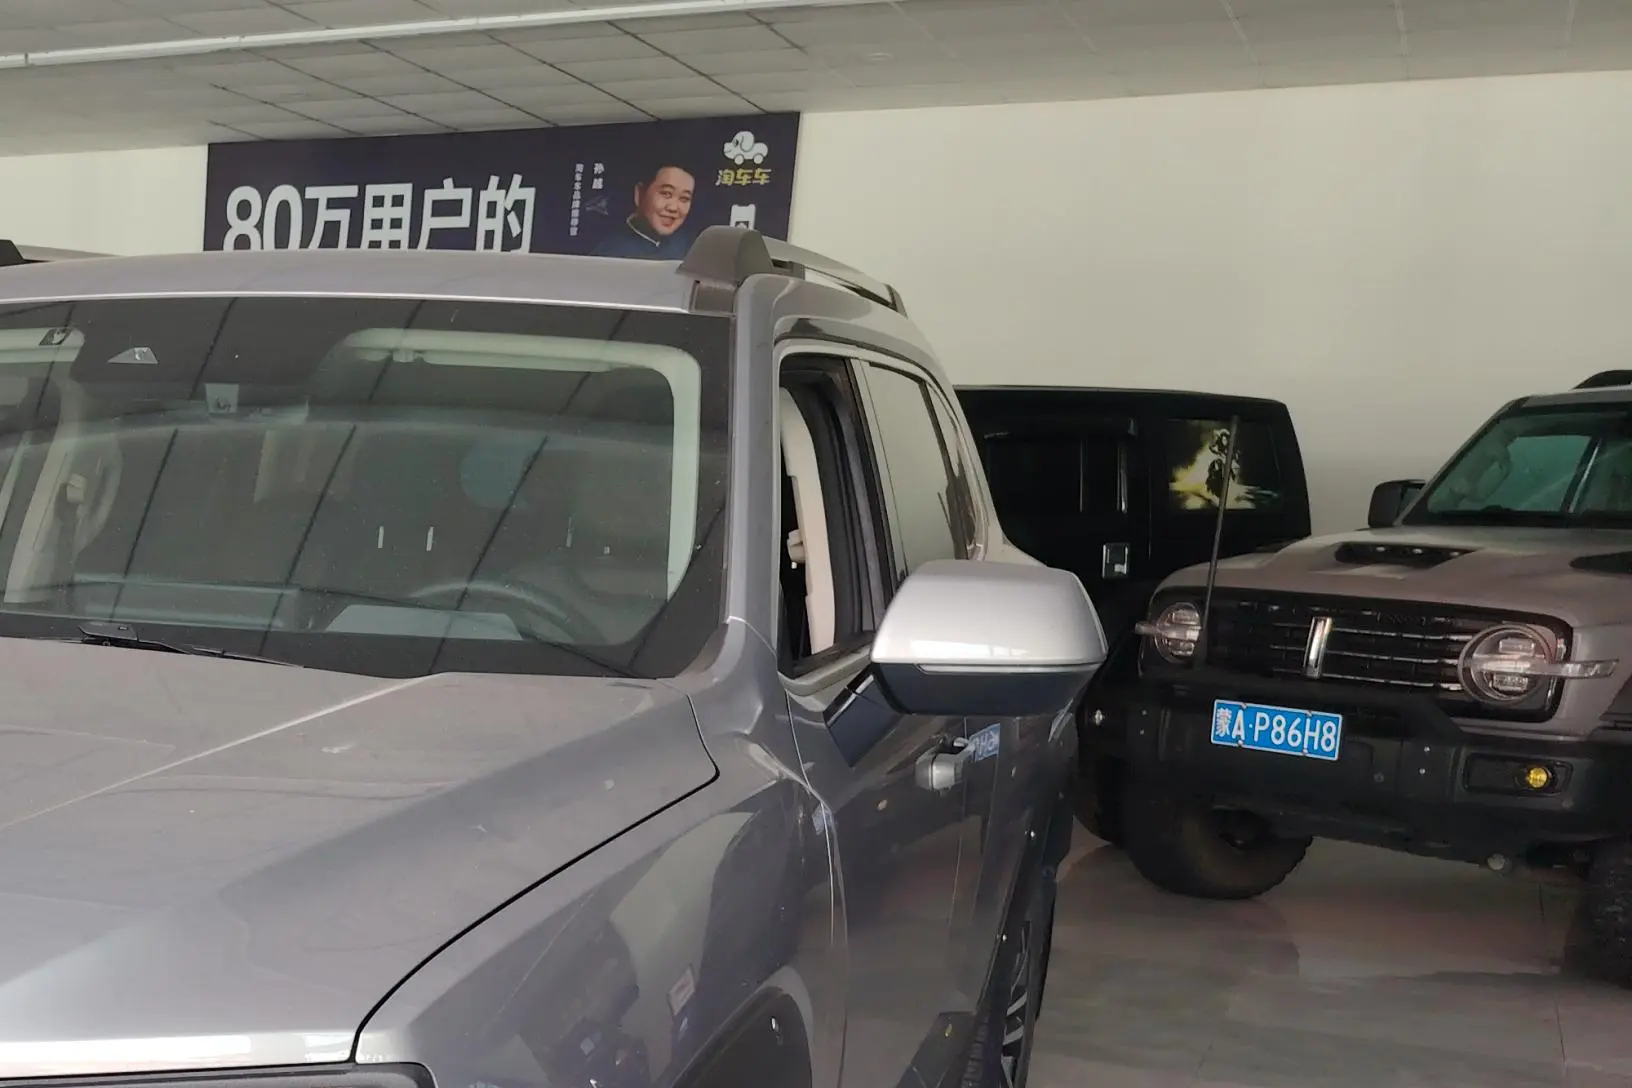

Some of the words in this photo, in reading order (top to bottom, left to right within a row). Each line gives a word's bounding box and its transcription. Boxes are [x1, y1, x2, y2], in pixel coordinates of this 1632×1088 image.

[715, 167, 772, 186] 淘车车
[223, 174, 536, 253] 80万用户的
